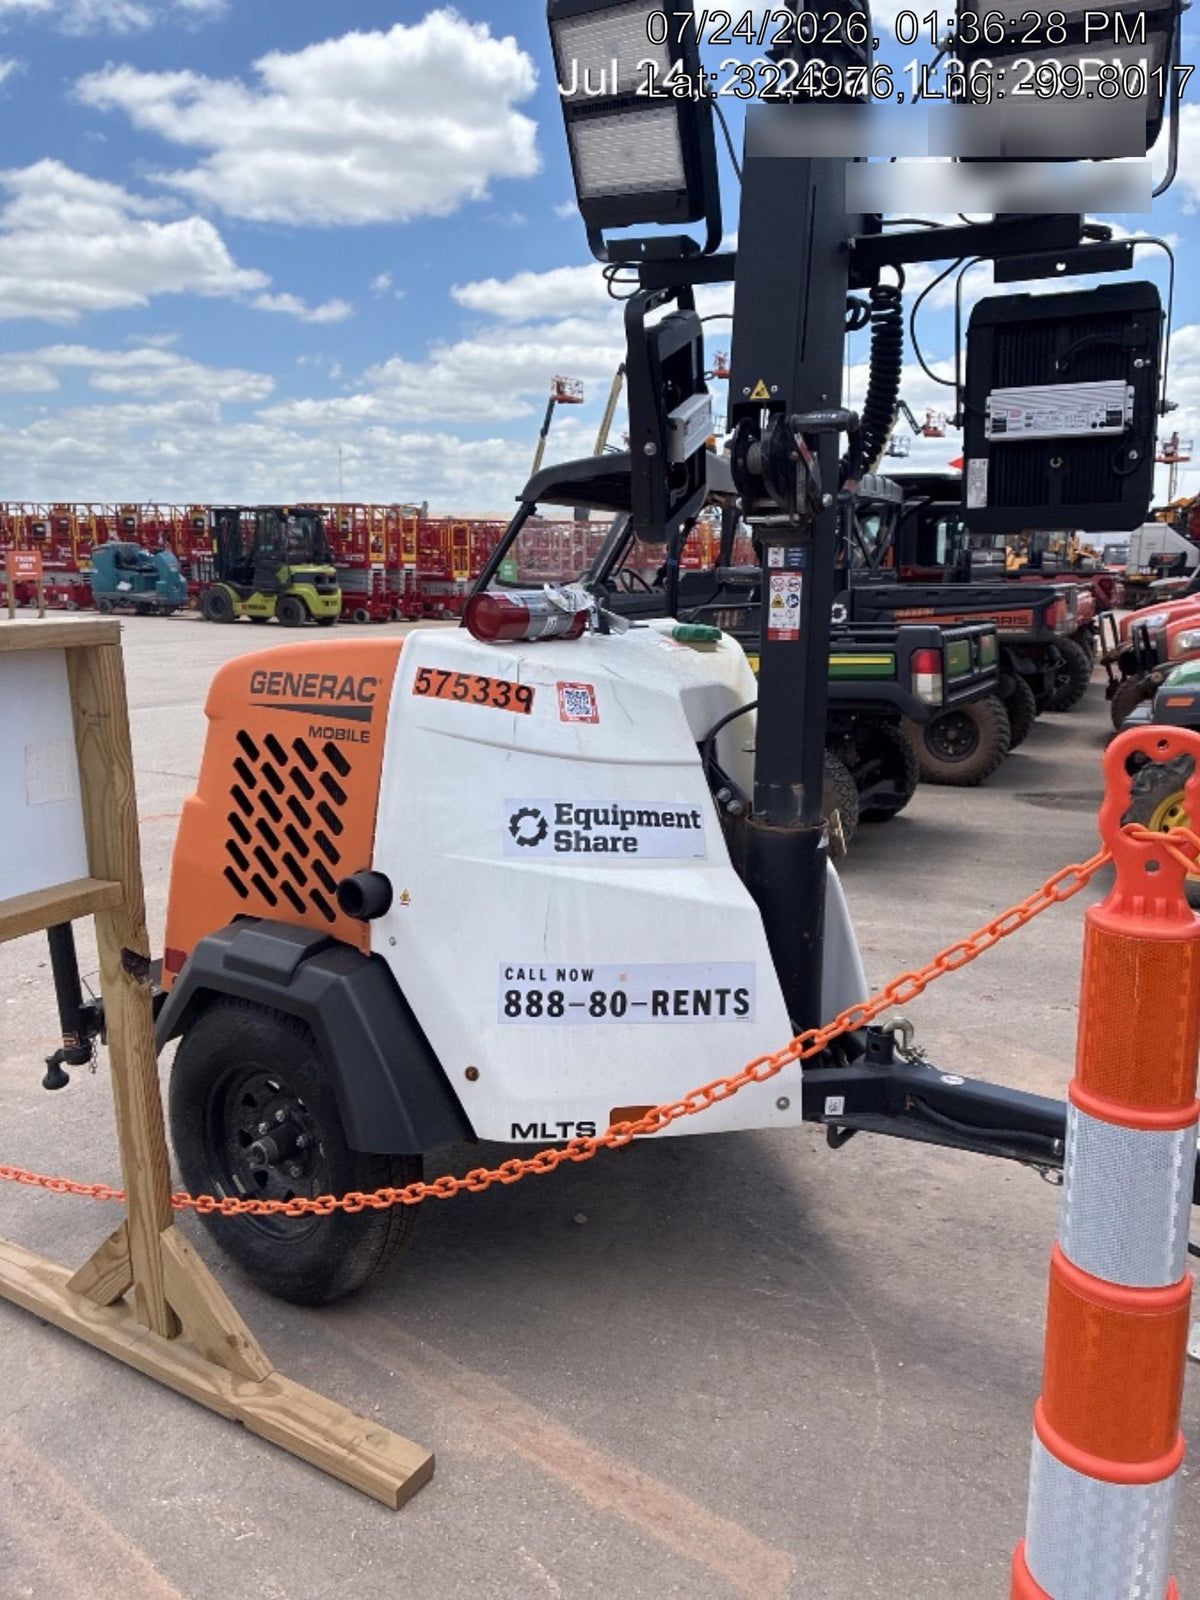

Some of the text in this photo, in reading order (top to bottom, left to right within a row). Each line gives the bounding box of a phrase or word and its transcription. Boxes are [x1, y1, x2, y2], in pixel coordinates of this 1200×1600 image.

[250, 669, 377, 703] GENERAC
[415, 668, 534, 714] 575339
[308, 725, 371, 744] MOBILE
[554, 803, 702, 831] Equipment
[554, 830, 638, 852] Share
[504, 967, 595, 982] CALL NOW
[504, 988, 750, 1018] 888-80-RENTS
[510, 1121, 597, 1140] MLTS
